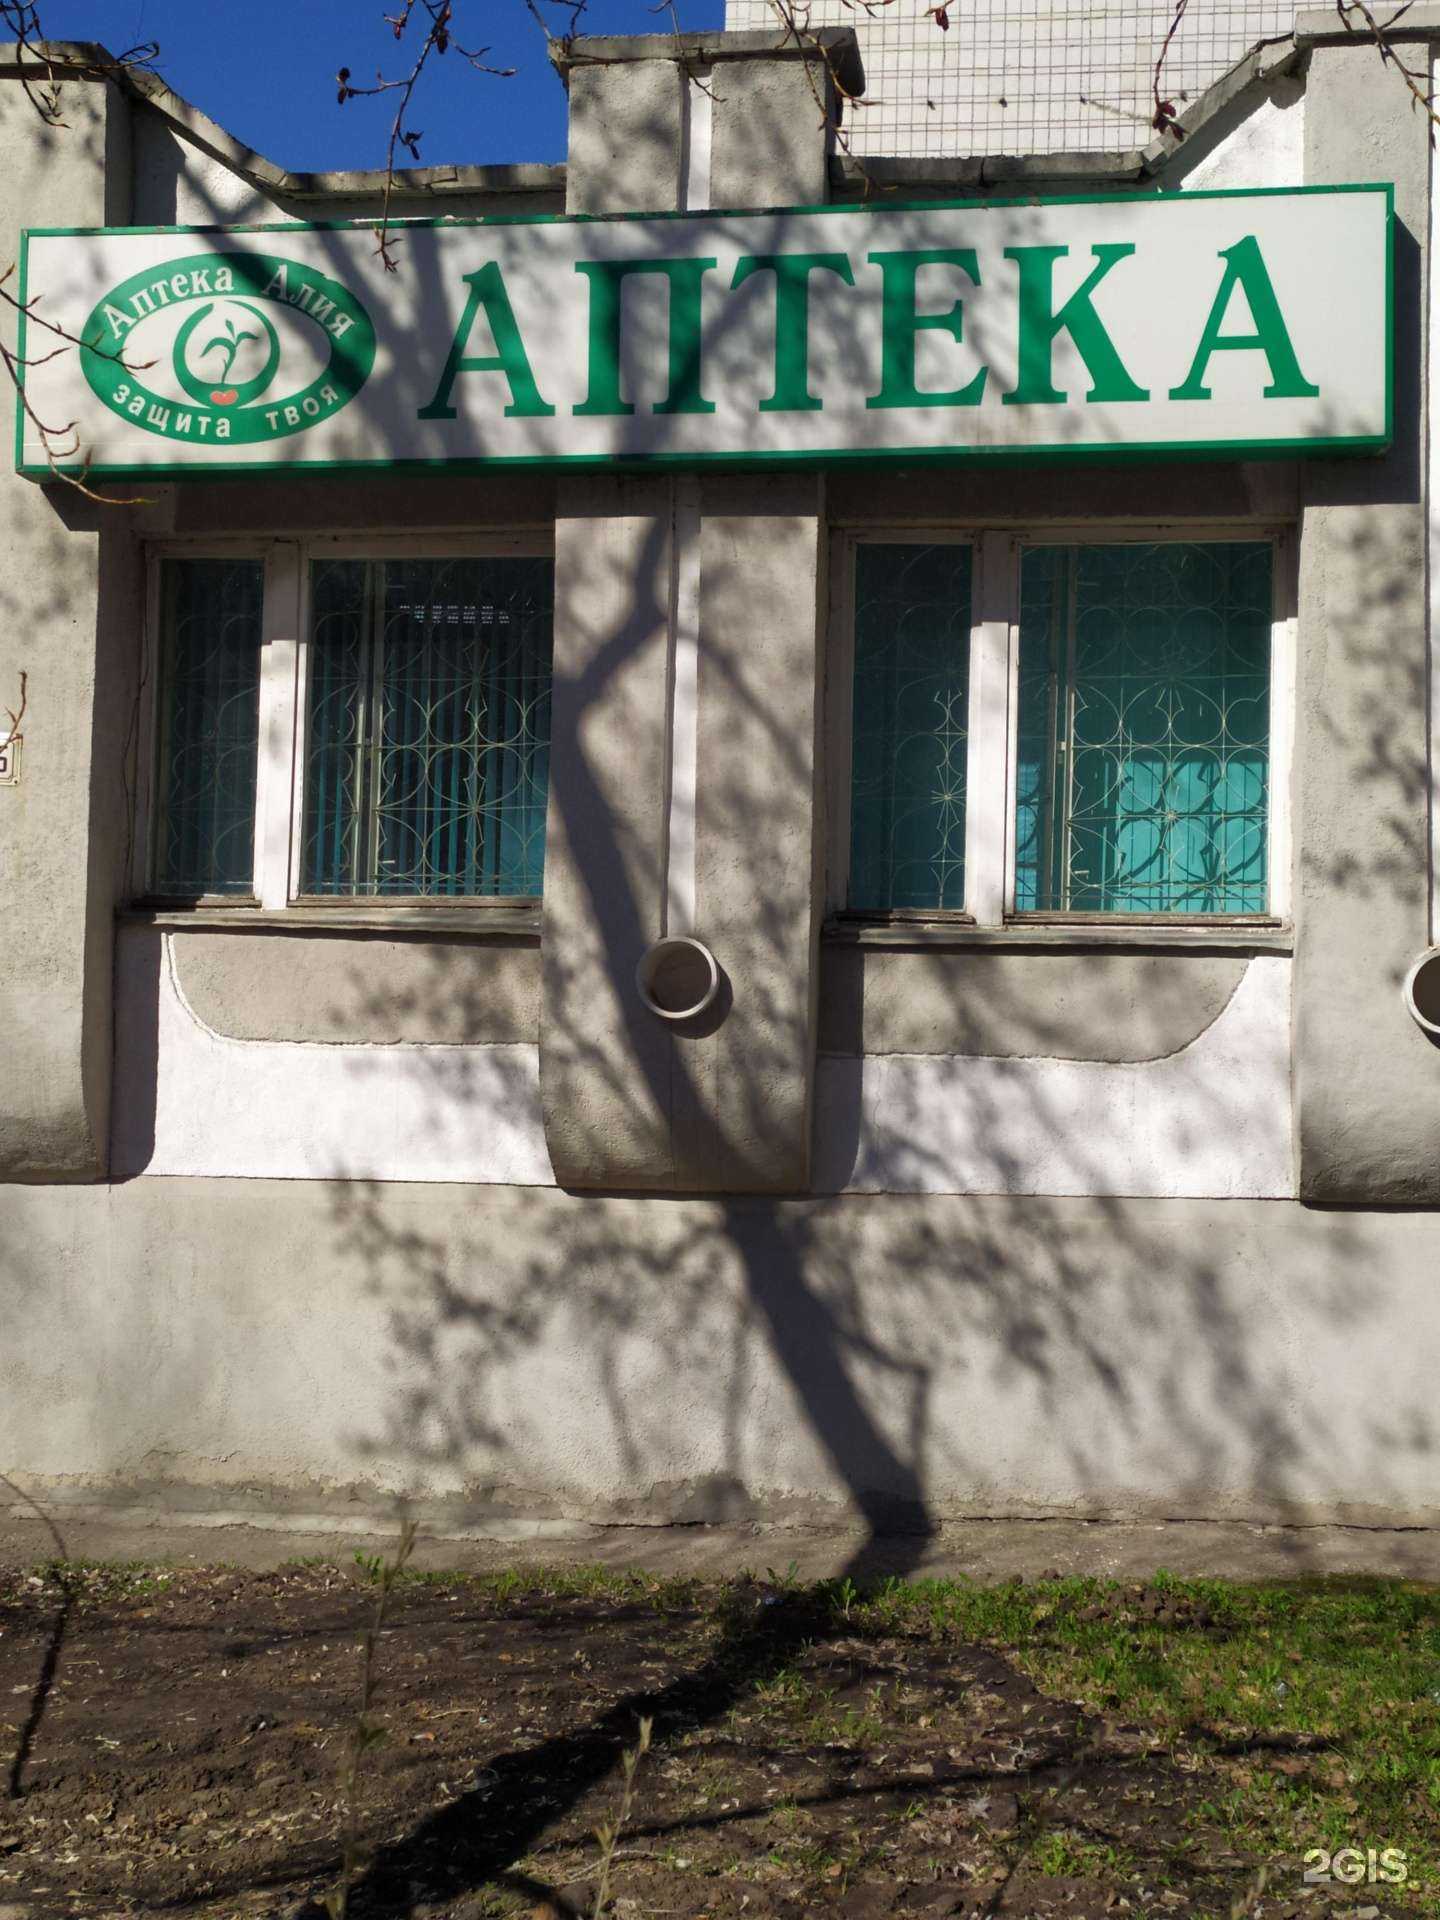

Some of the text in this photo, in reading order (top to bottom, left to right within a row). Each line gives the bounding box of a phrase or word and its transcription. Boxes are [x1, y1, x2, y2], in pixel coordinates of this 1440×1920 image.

[101, 263, 357, 341] Аптека Алия
[417, 234, 1320, 420] АПТЕКА
[112, 383, 340, 439] защита твоя
